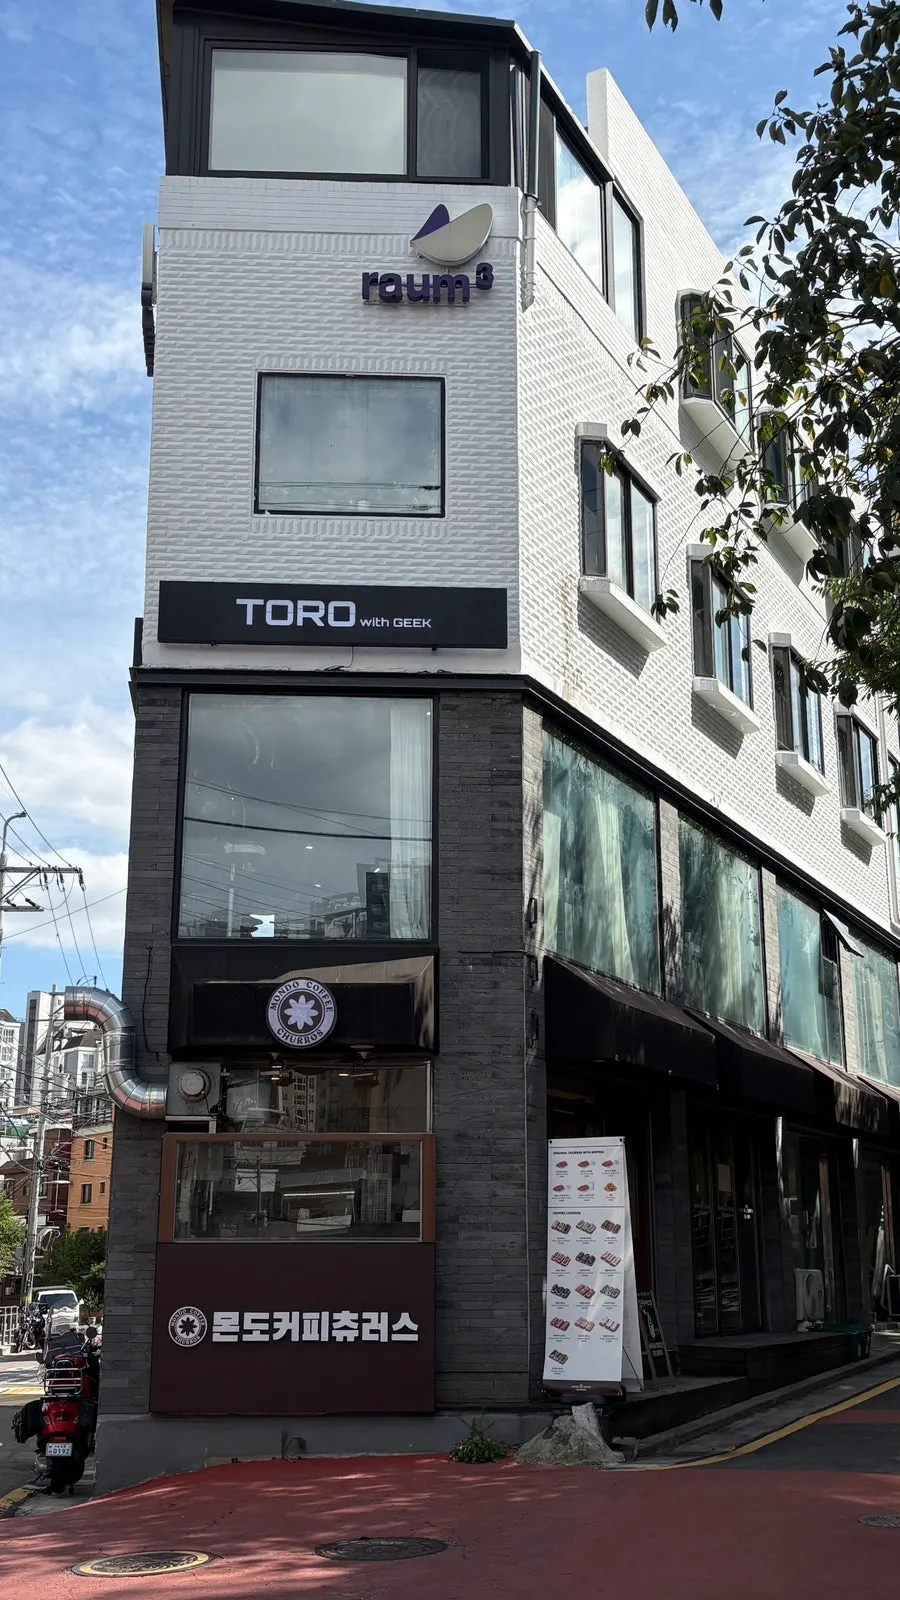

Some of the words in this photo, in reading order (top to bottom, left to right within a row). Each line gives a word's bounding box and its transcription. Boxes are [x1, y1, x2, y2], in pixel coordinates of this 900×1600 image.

[236, 599, 356, 627] TORO
[360, 618, 390, 627] with
[393, 618, 432, 628] GEEK
[270, 981, 300, 1010] MONDO
[306, 981, 334, 1012] COFFEE
[277, 1028, 324, 1045] CHURROS
[212, 1311, 419, 1342] 몬도커피츄러스
